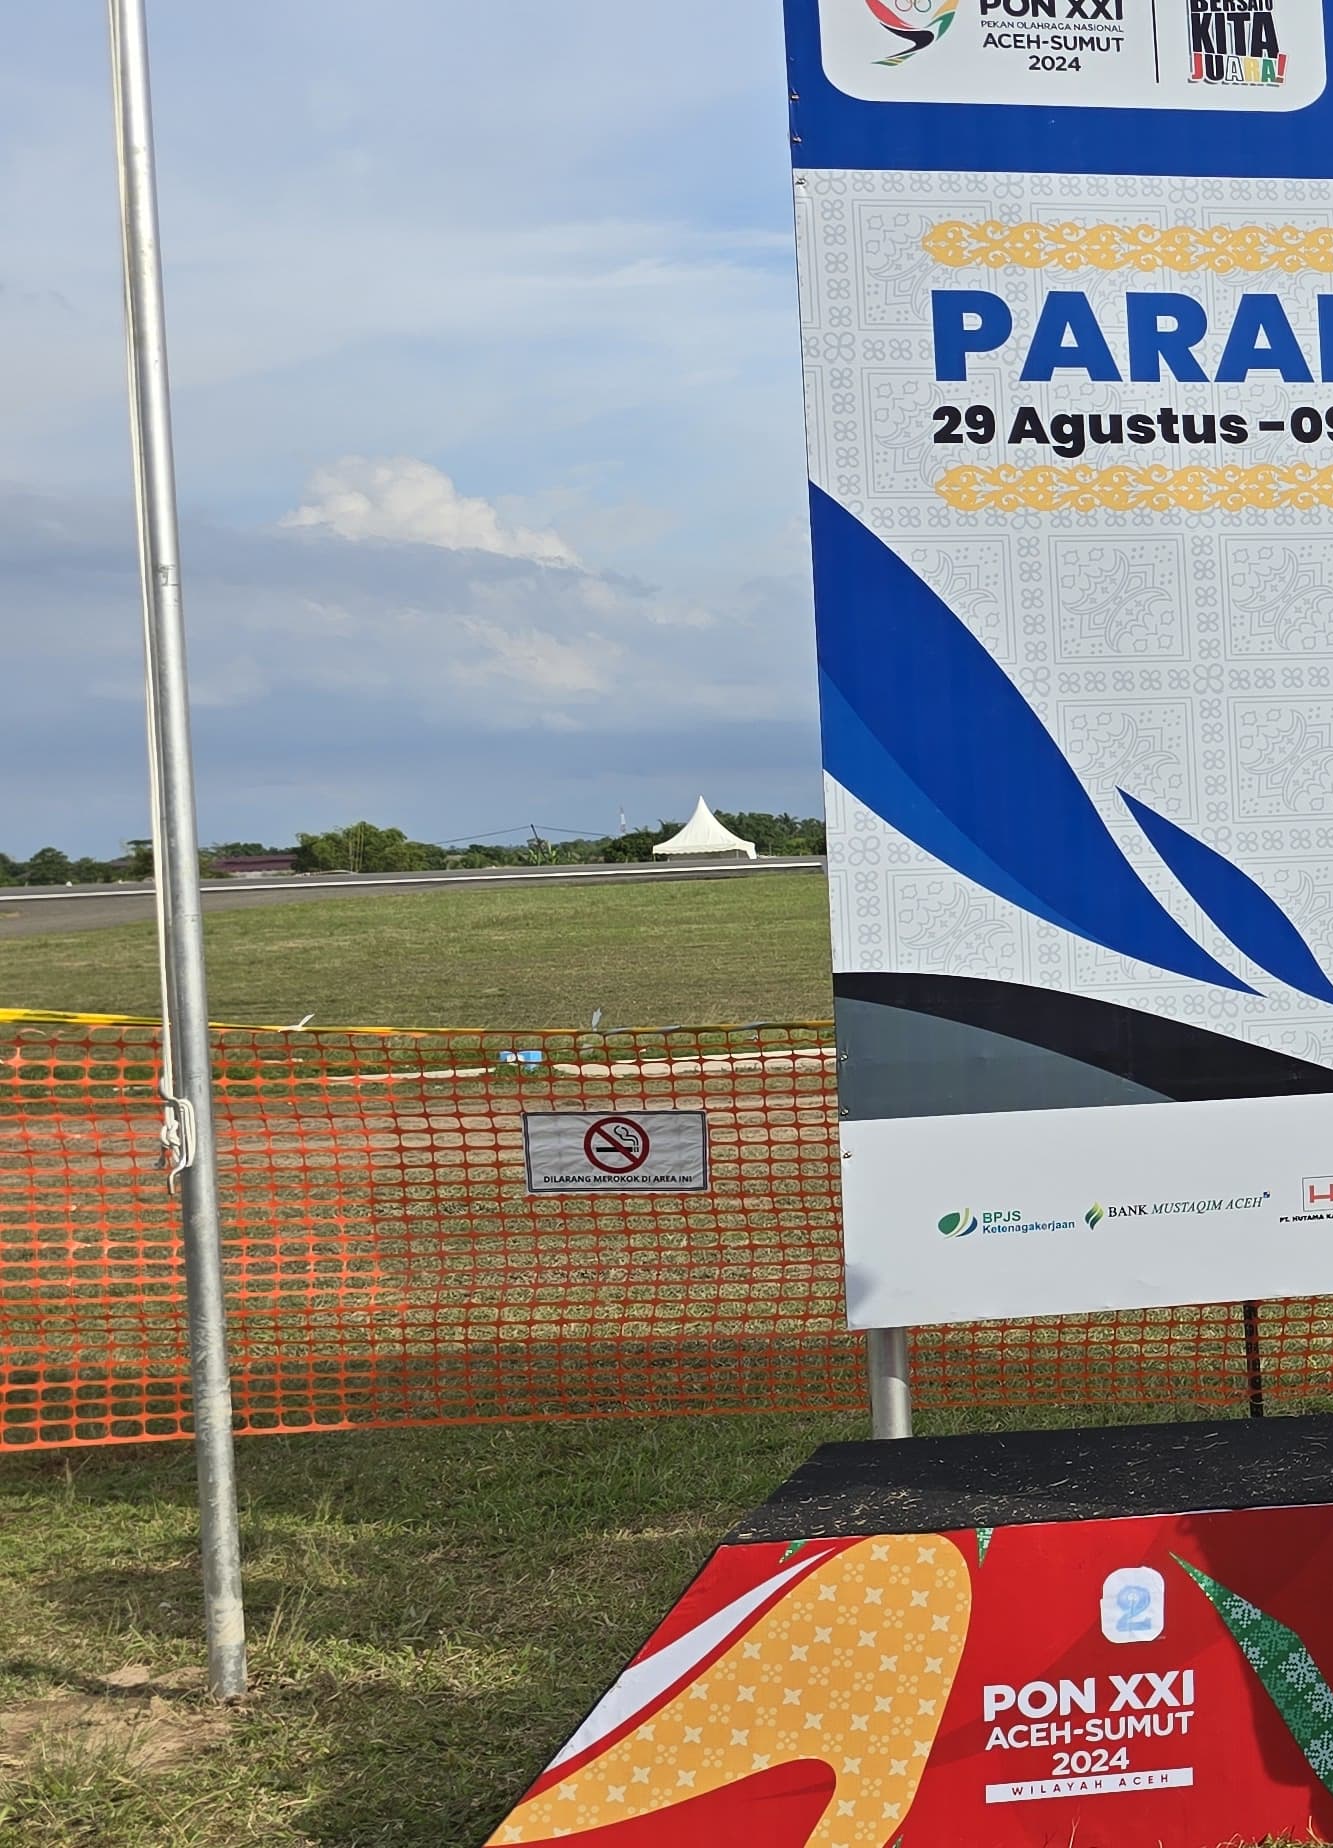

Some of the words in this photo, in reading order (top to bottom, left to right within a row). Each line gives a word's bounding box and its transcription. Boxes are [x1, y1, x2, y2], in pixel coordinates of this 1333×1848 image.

[980, 0, 1056, 18] PON
[1066, 0, 1124, 20] XXI
[981, 20, 1014, 29] PEKAN
[1016, 21, 1072, 31] OLAHRAGA
[1073, 23, 1124, 33] NASIONAL
[1192, 12, 1279, 58] KITA
[983, 33, 1124, 52] ACEH-SUMUT
[1028, 55, 1081, 71] 2024
[1191, 53, 1287, 83] JUARA!
[932, 405, 996, 444] 29
[1007, 404, 1248, 458] Agustus
[543, 1175, 591, 1183] DILARANG
[594, 1175, 640, 1183] MEROKOK
[641, 1175, 651, 1183] DI
[653, 1175, 676, 1183] AREA
[678, 1175, 693, 1183] INI
[982, 1210, 1022, 1224] BPJS
[1108, 1204, 1147, 1218] BANK
[1151, 1199, 1223, 1215] MUSTAQIM
[1225, 1196, 1263, 1210] ACEH
[982, 1220, 1075, 1234] Ketenagakerjaan
[1116, 1585, 1152, 1632] 2
[983, 1676, 1096, 1722] PON
[1108, 1668, 1195, 1710] XXI
[985, 1710, 1195, 1751] ACEH-SUMUT
[1052, 1746, 1130, 1776] 2024
[1011, 1779, 1104, 1797] WILAYAH
[1118, 1773, 1171, 1788] ACEH
